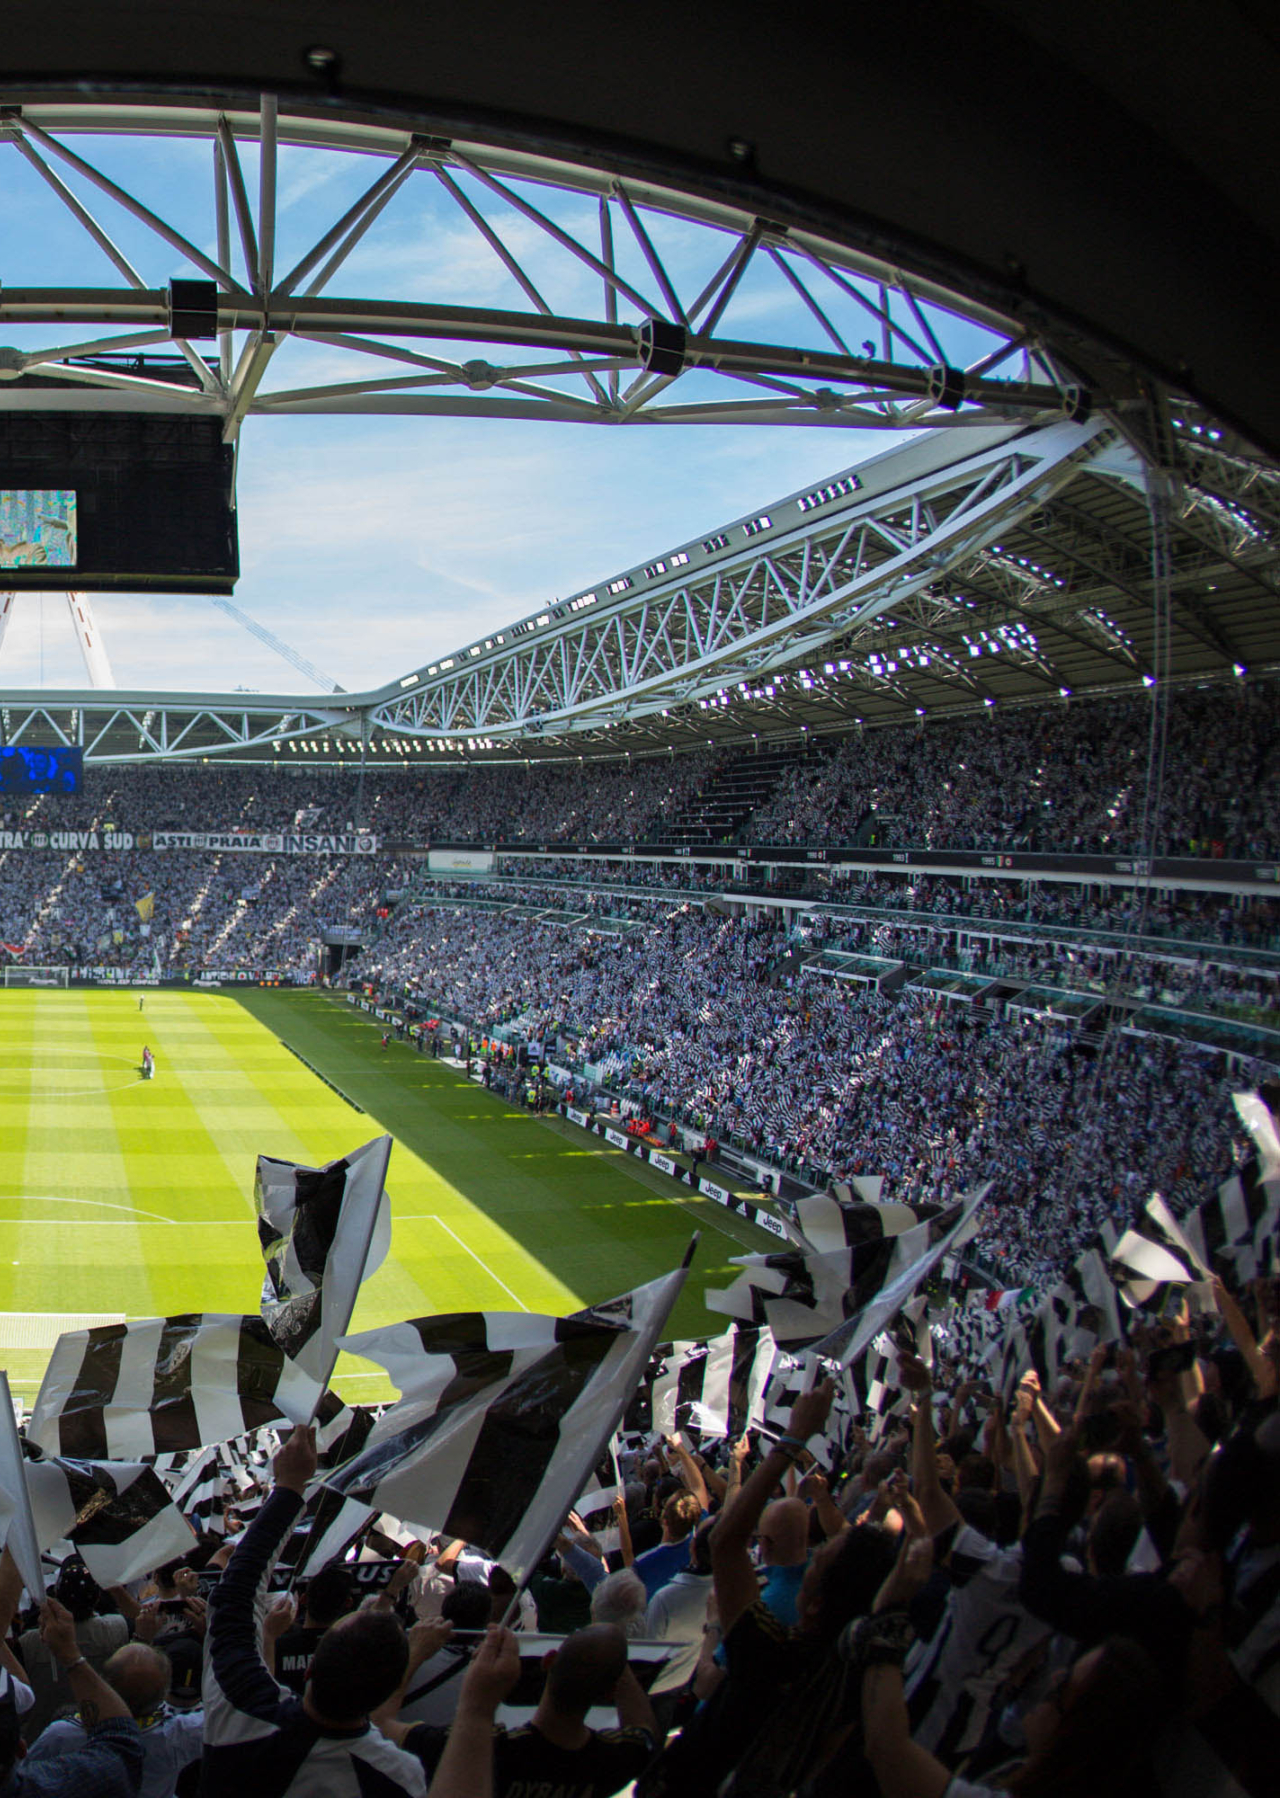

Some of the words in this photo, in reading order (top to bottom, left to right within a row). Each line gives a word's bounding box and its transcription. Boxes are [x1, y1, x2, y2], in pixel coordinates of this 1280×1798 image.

[50, 831, 99, 849] CURVA
[103, 832, 133, 849] SUD
[154, 834, 191, 847] ASTI
[209, 836, 262, 848] PRAIA
[283, 835, 356, 852] INSANI
[609, 1131, 623, 1147] Jeep
[654, 1154, 670, 1171] Jeep
[705, 1181, 722, 1203] Jeep
[763, 1214, 782, 1234] Jeep
